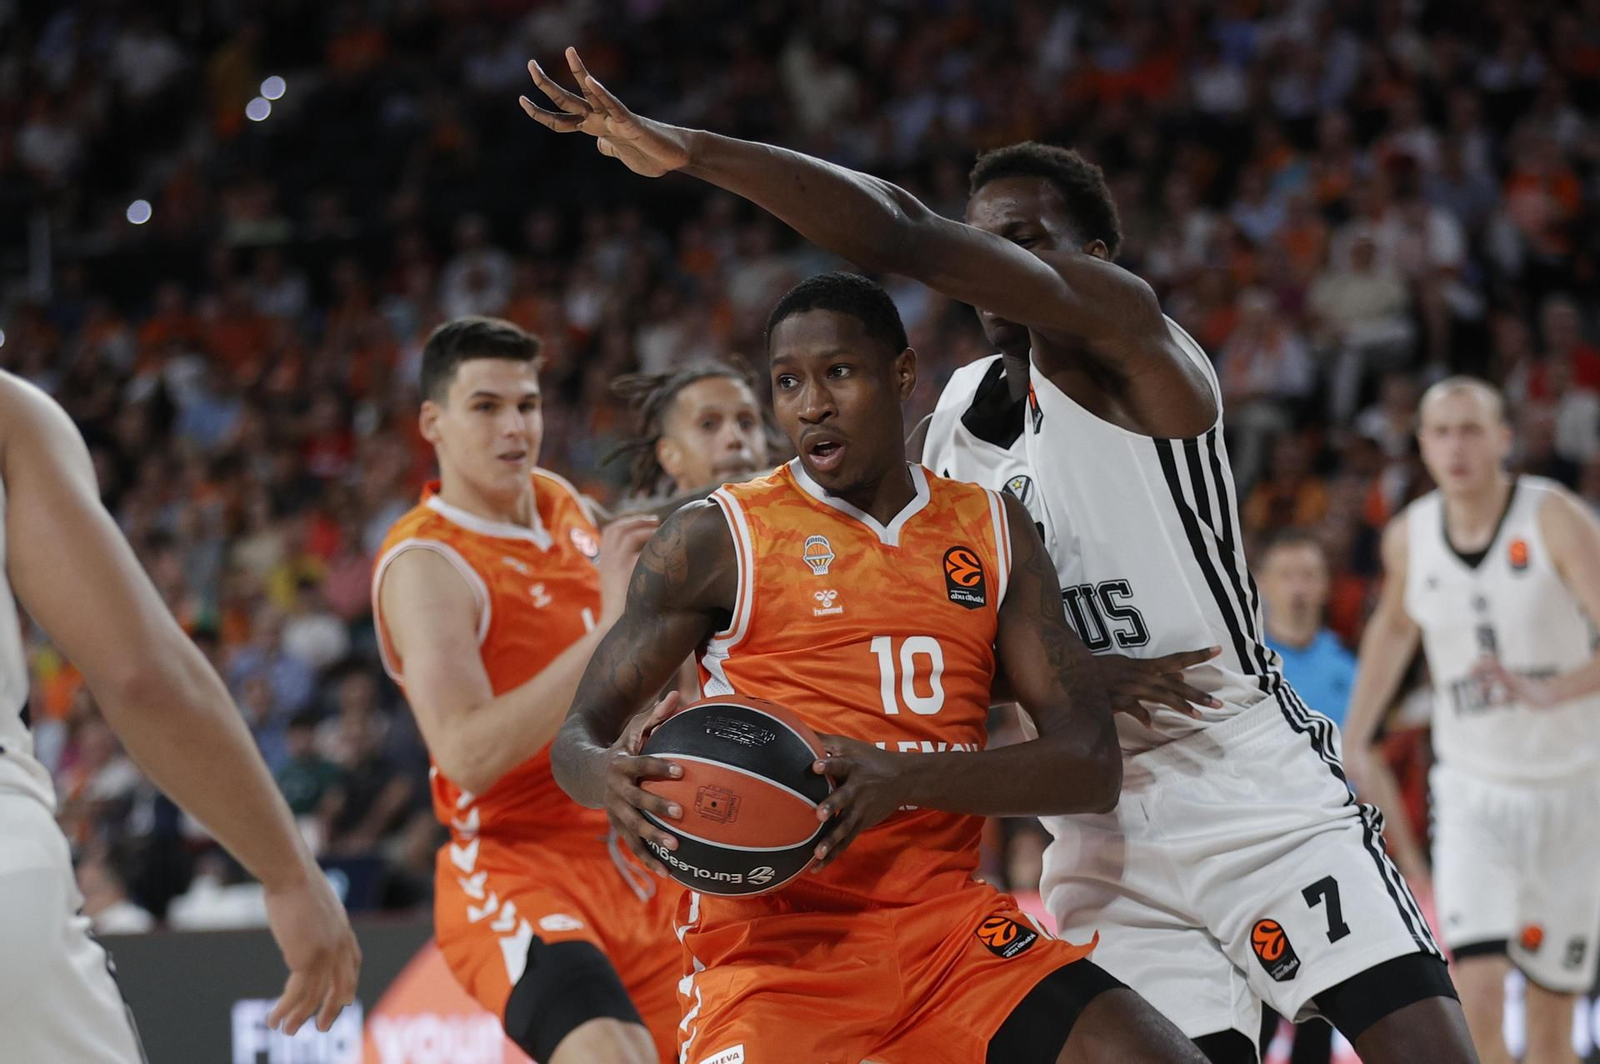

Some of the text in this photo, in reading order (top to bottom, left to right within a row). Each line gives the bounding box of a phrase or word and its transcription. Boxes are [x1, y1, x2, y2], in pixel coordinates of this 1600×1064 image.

[813, 605, 843, 617] hummel
[870, 636, 944, 714] 10
[1301, 875, 1350, 944] 7
